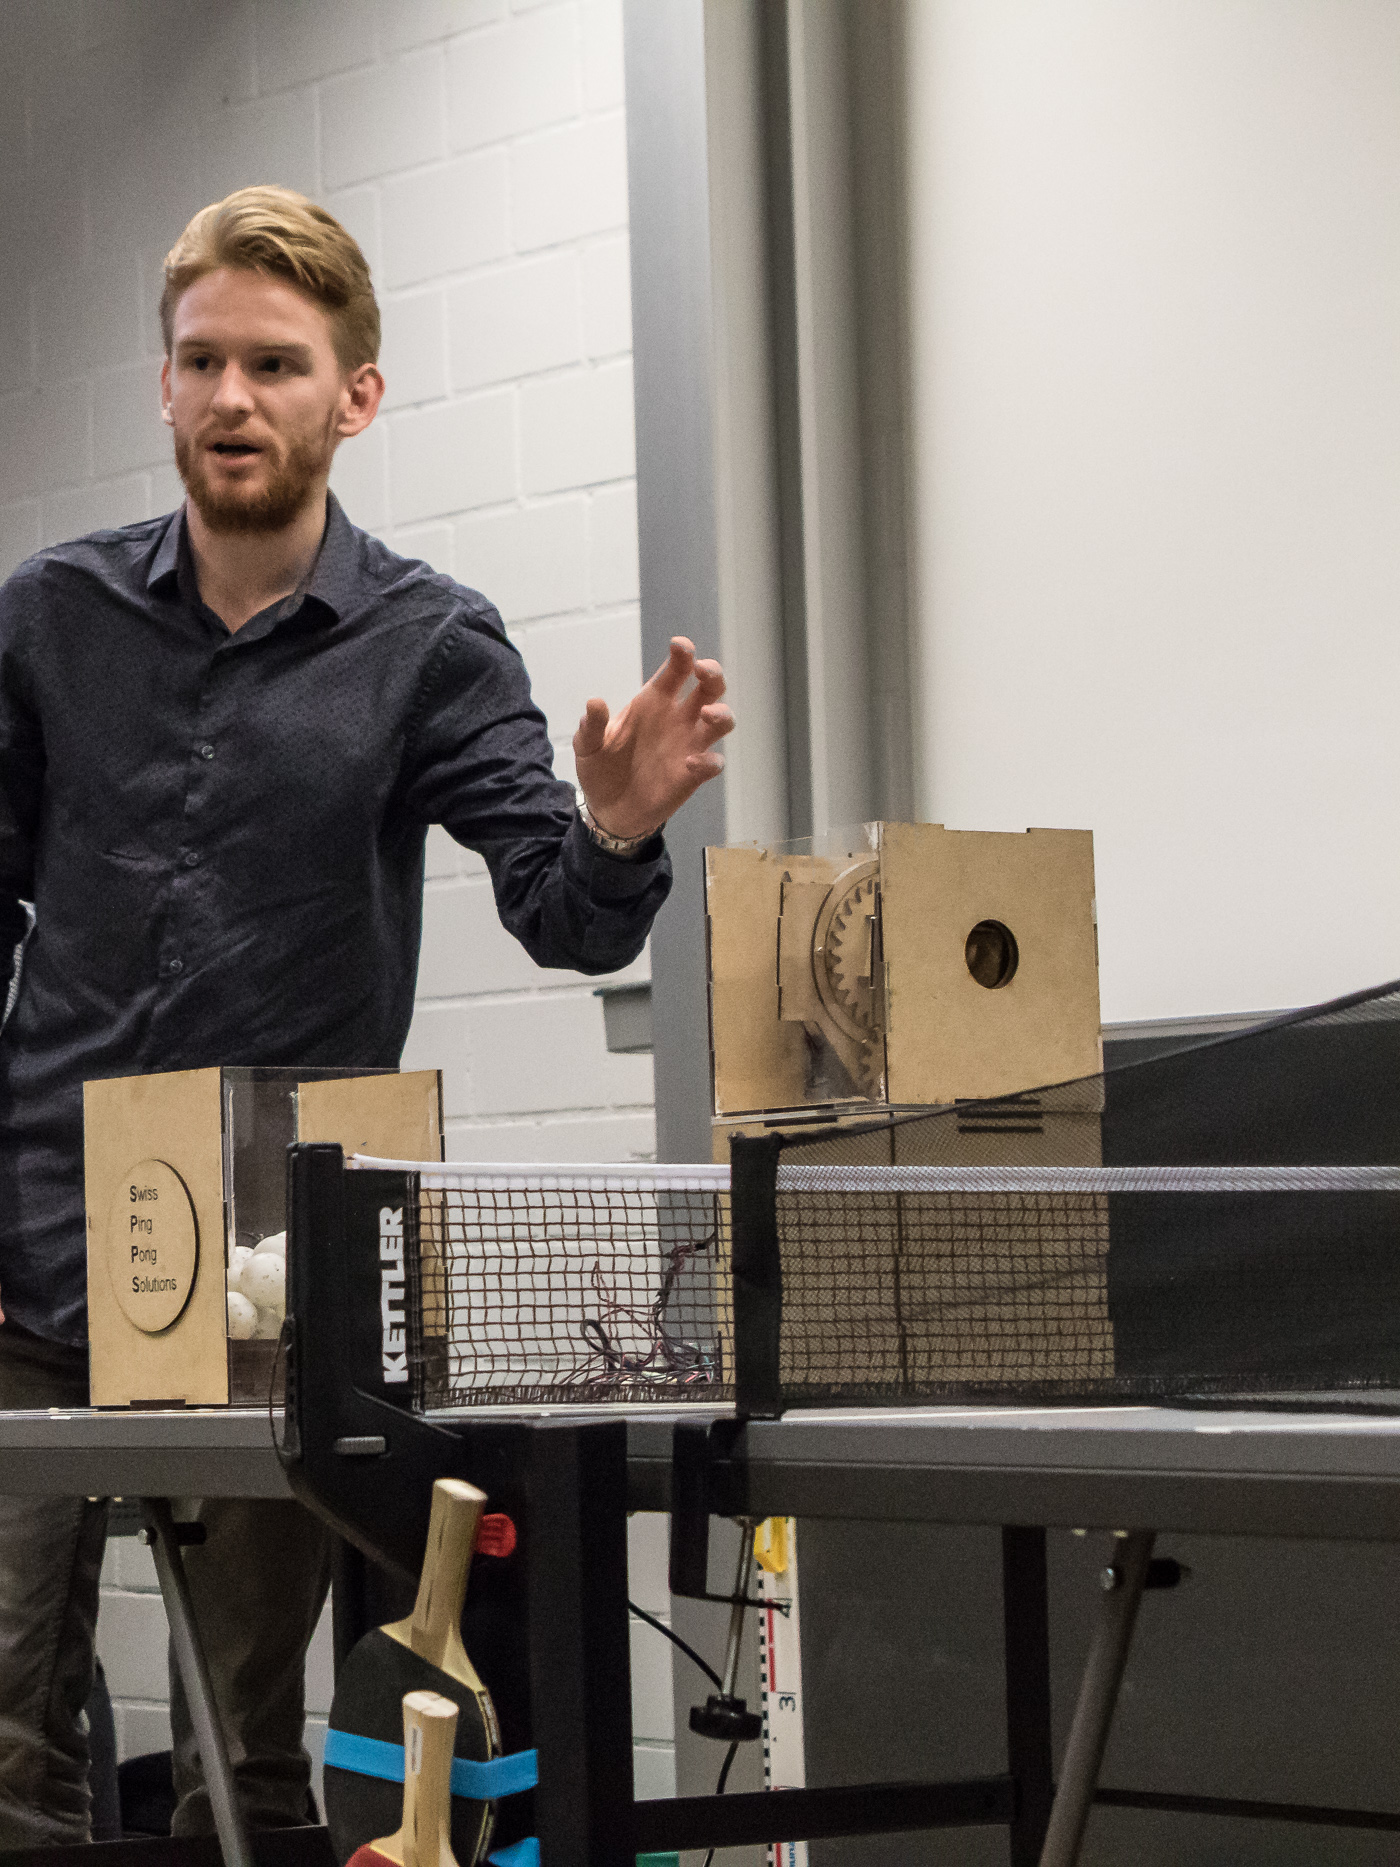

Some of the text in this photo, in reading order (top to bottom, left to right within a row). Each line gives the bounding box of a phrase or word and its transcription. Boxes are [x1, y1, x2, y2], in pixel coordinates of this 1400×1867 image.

[130, 1185, 158, 1203] Swiss
[130, 1215, 153, 1234] Ping
[131, 1246, 157, 1265] Pong
[132, 1276, 177, 1293] Solutions
[379, 1207, 409, 1383] KETTLER
[779, 1696, 795, 1712] 3
